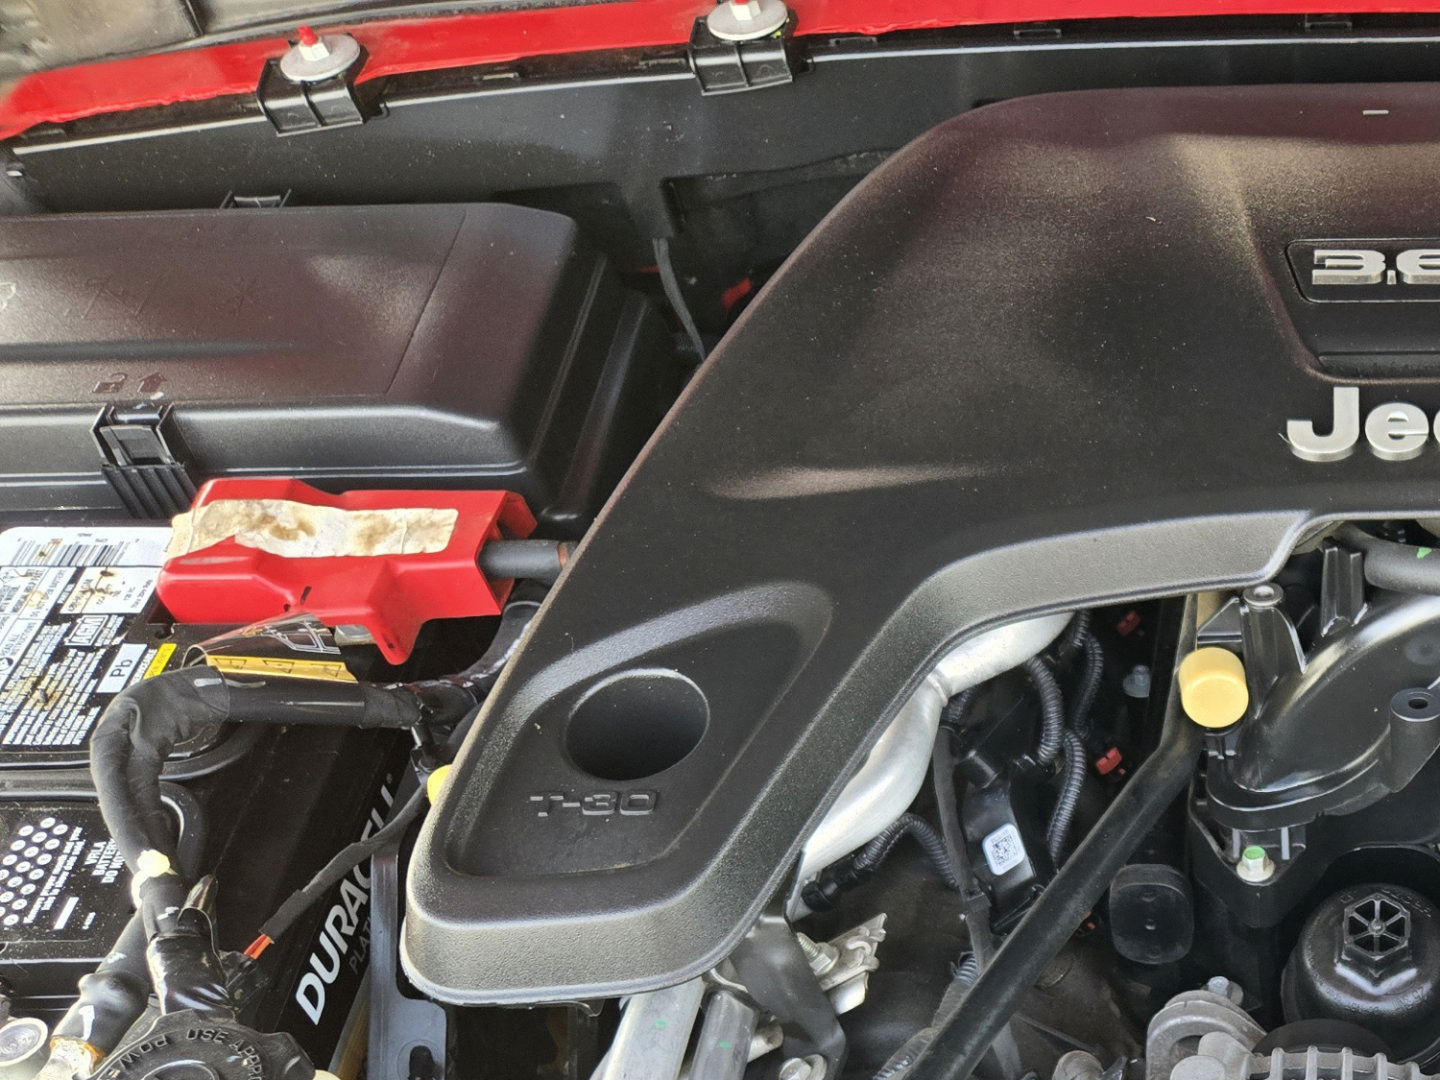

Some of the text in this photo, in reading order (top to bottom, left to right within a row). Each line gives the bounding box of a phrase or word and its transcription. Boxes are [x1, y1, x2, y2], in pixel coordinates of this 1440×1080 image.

[69, 617, 105, 642] AGM
[109, 658, 134, 677] Pb
[83, 841, 107, 865] VRLA
[100, 869, 119, 884] DO
[185, 1028, 229, 1045] USE
